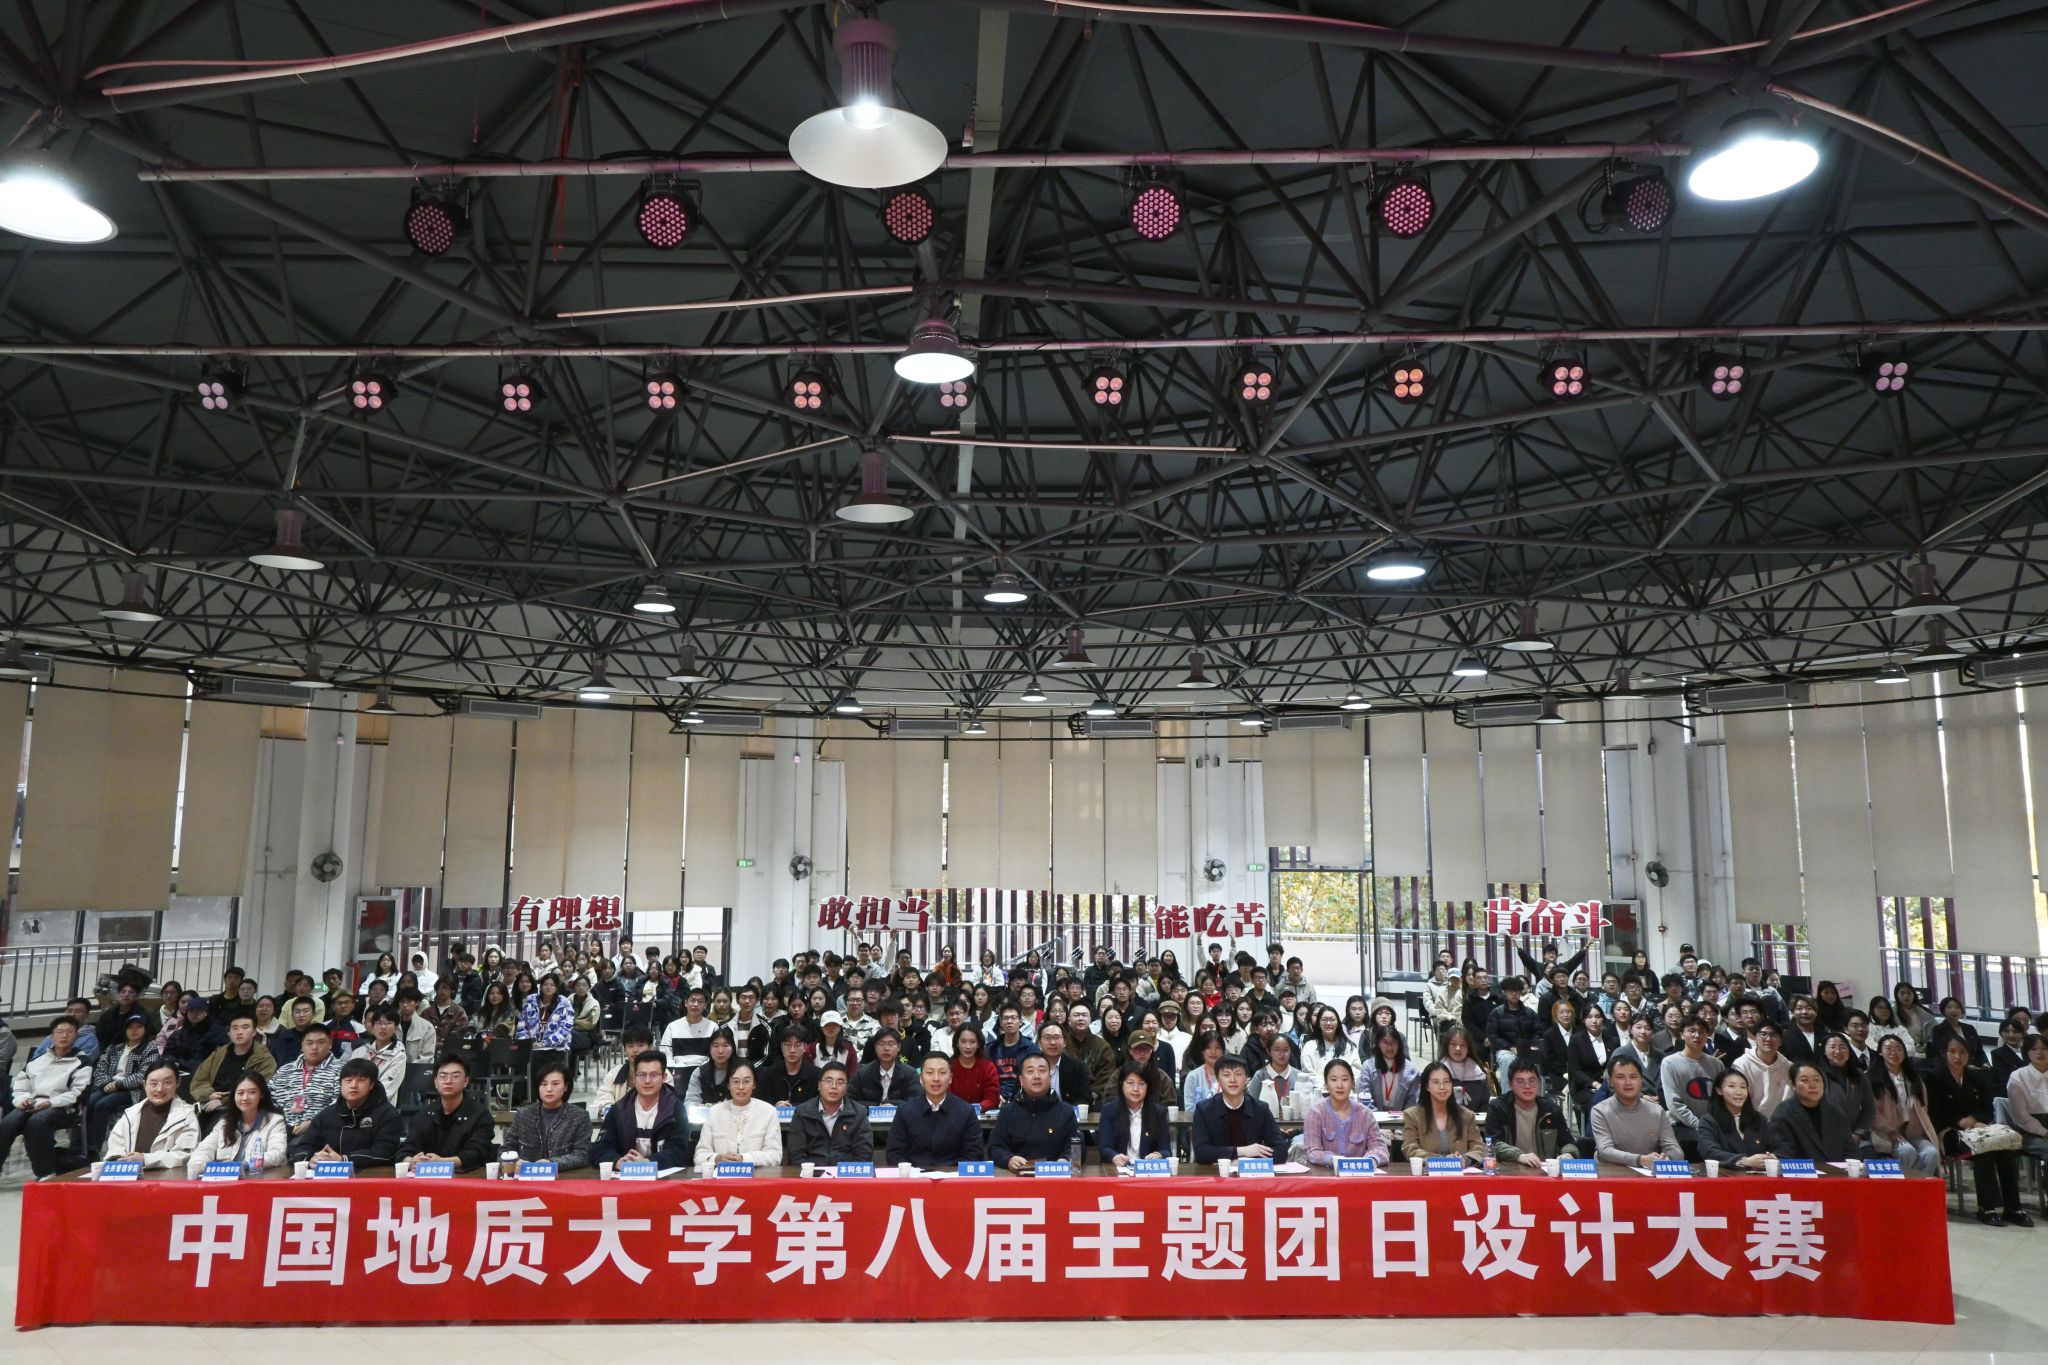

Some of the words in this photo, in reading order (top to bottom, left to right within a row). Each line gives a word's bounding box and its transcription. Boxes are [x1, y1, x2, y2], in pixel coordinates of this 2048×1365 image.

[508, 896, 622, 931] 有理想
[817, 896, 930, 933] 敢担当
[1154, 902, 1266, 939] 能吃苦
[1484, 898, 1611, 938] 肯奋斗
[104, 1164, 139, 1173] 公共管理学院
[419, 1166, 450, 1174] 自动化学院
[524, 1166, 553, 1174] 工程学院
[719, 1166, 752, 1174] 地球科学学院
[840, 1165, 871, 1174] 本科生院
[1137, 1163, 1168, 1171] 研究生院
[1342, 1162, 1370, 1170] 环境学院
[1656, 1164, 1689, 1172] 经济管理学院
[1868, 1163, 1901, 1171] 珠宝学院
[167, 1193, 1827, 1289] 中国地质大学第八届主题团日设计大赛
